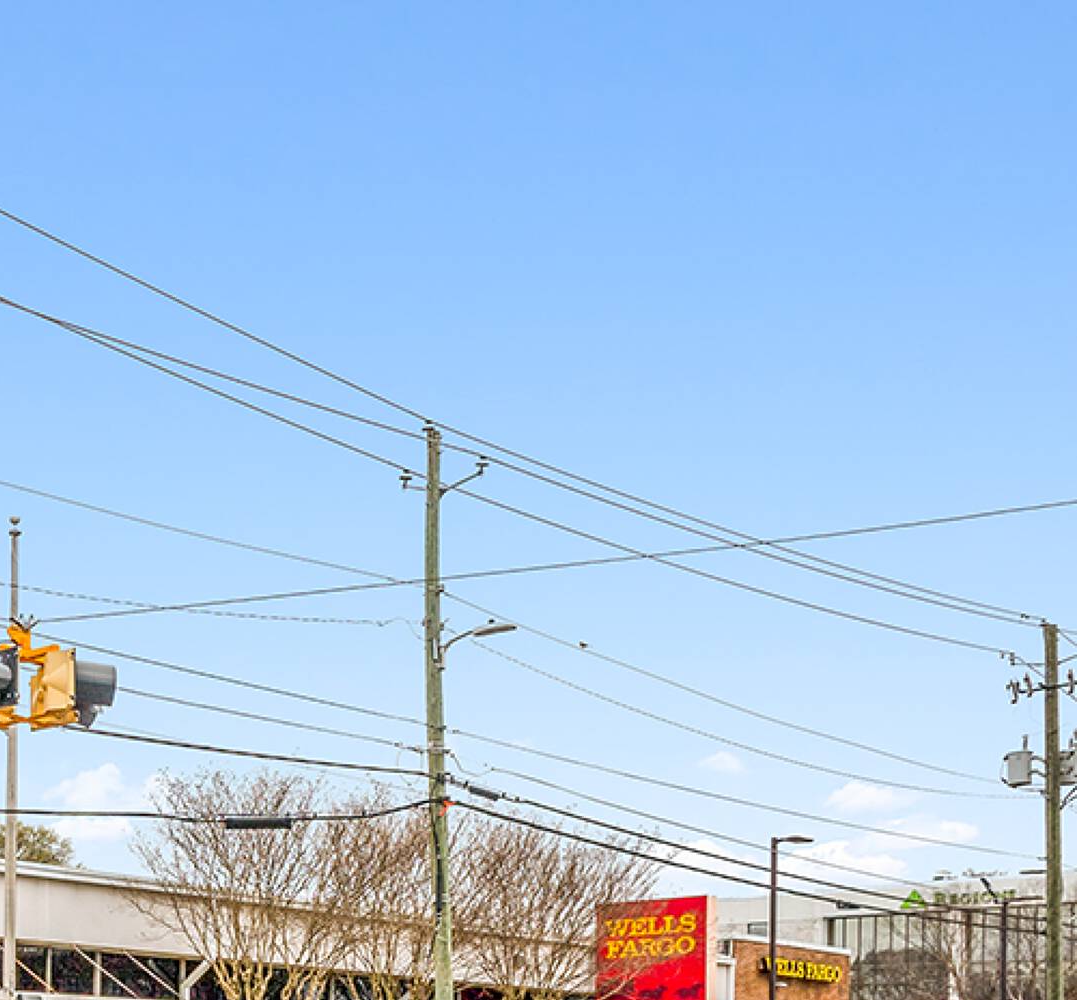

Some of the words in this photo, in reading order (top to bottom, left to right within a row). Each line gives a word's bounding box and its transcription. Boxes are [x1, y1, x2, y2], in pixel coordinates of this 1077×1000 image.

[605, 912, 697, 937] WELLS
[605, 935, 697, 959] FARGO
[806, 961, 843, 983] FARGO
